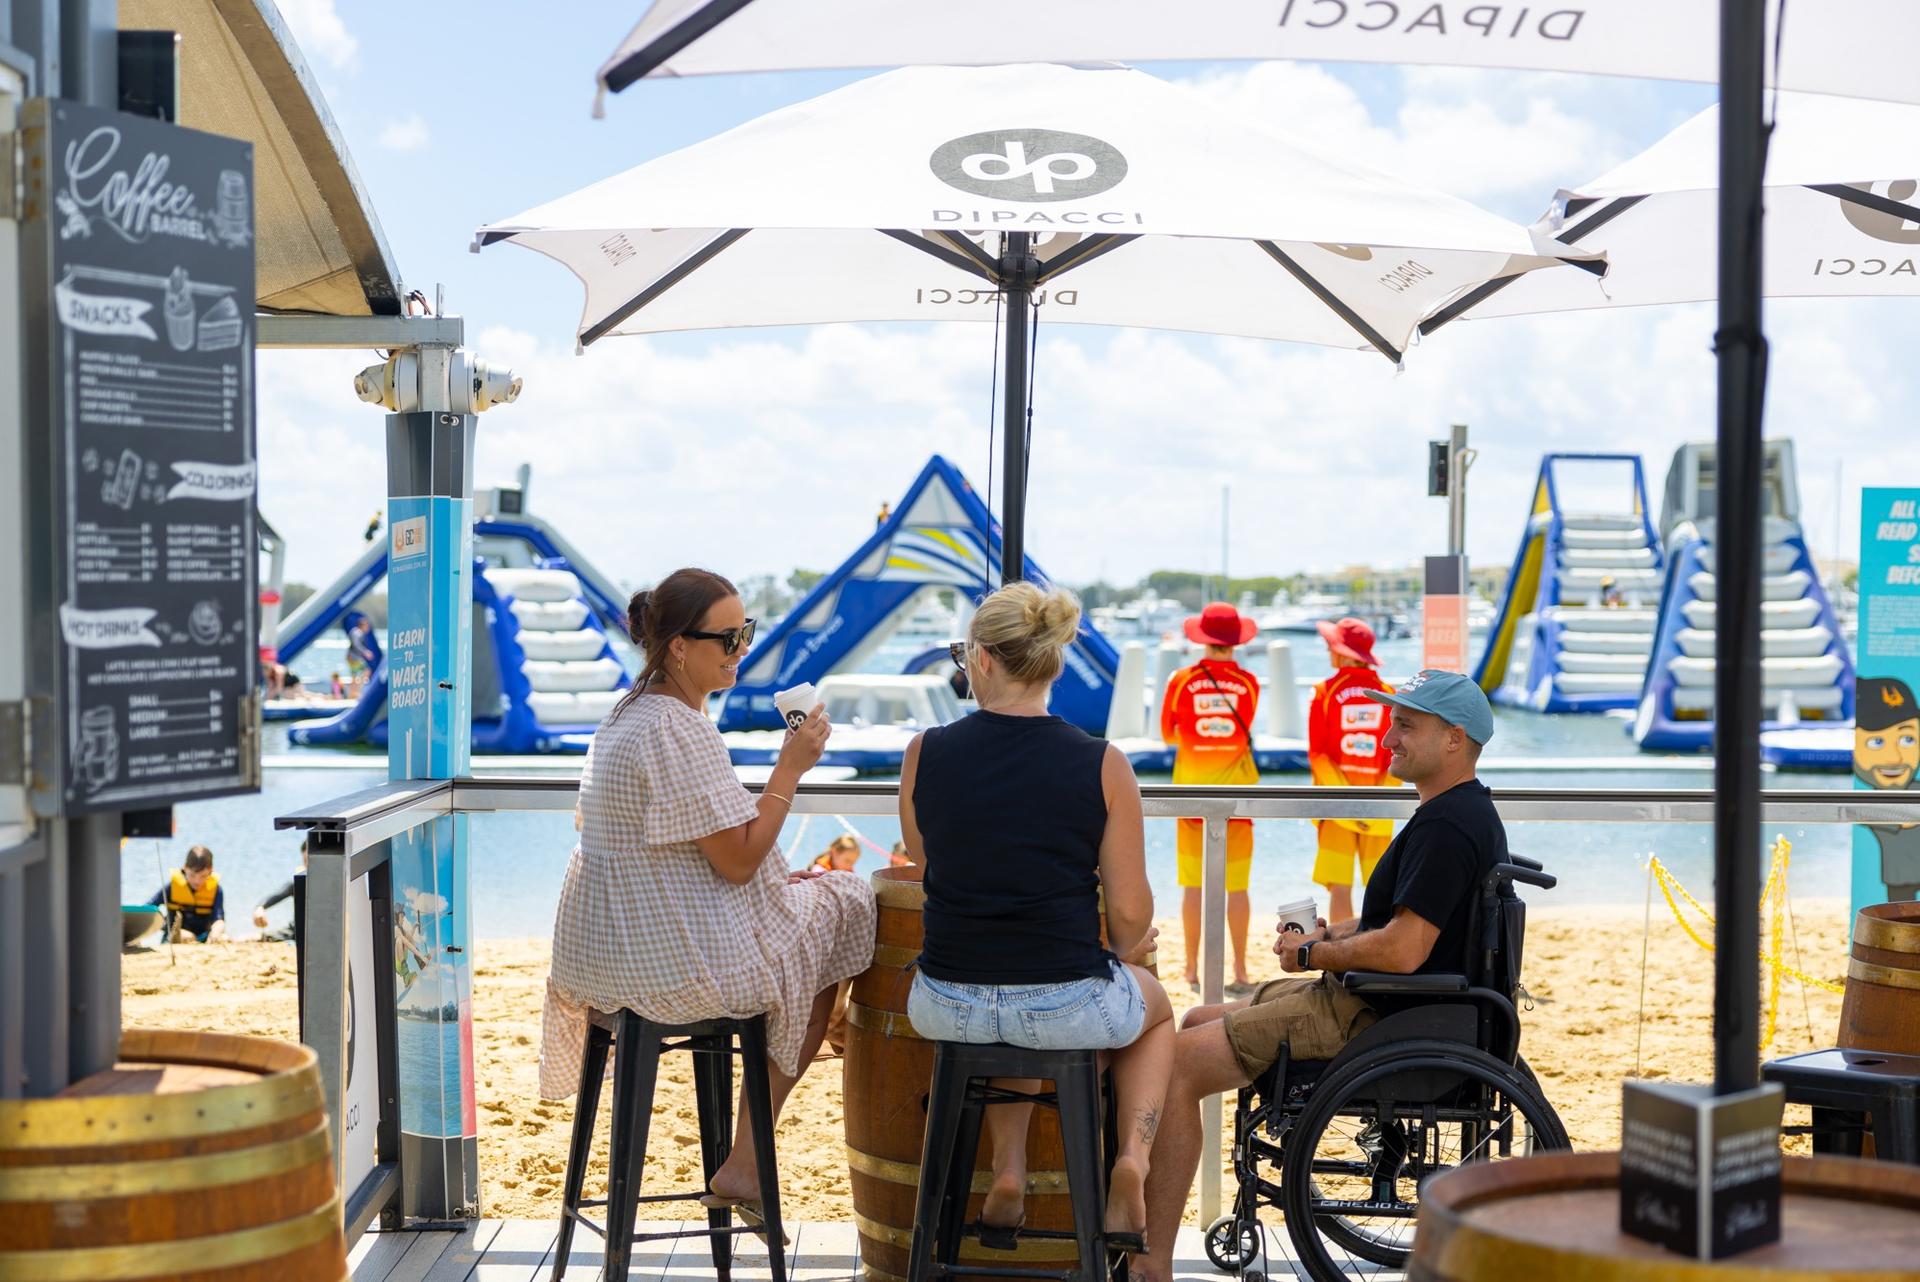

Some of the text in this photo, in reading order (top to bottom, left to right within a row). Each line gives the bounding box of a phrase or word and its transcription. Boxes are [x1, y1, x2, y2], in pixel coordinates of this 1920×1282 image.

[65, 126, 195, 233] Coffee
[932, 210, 1144, 225] DIPACCI
[69, 299, 132, 325] SNACKS
[1876, 521, 1918, 541] READ
[68, 619, 140, 638] HOT DRINKS
[393, 627, 426, 650] LEARN
[404, 650, 414, 663] TO
[392, 664, 426, 688] WAKE
[391, 688, 426, 710] BOARD
